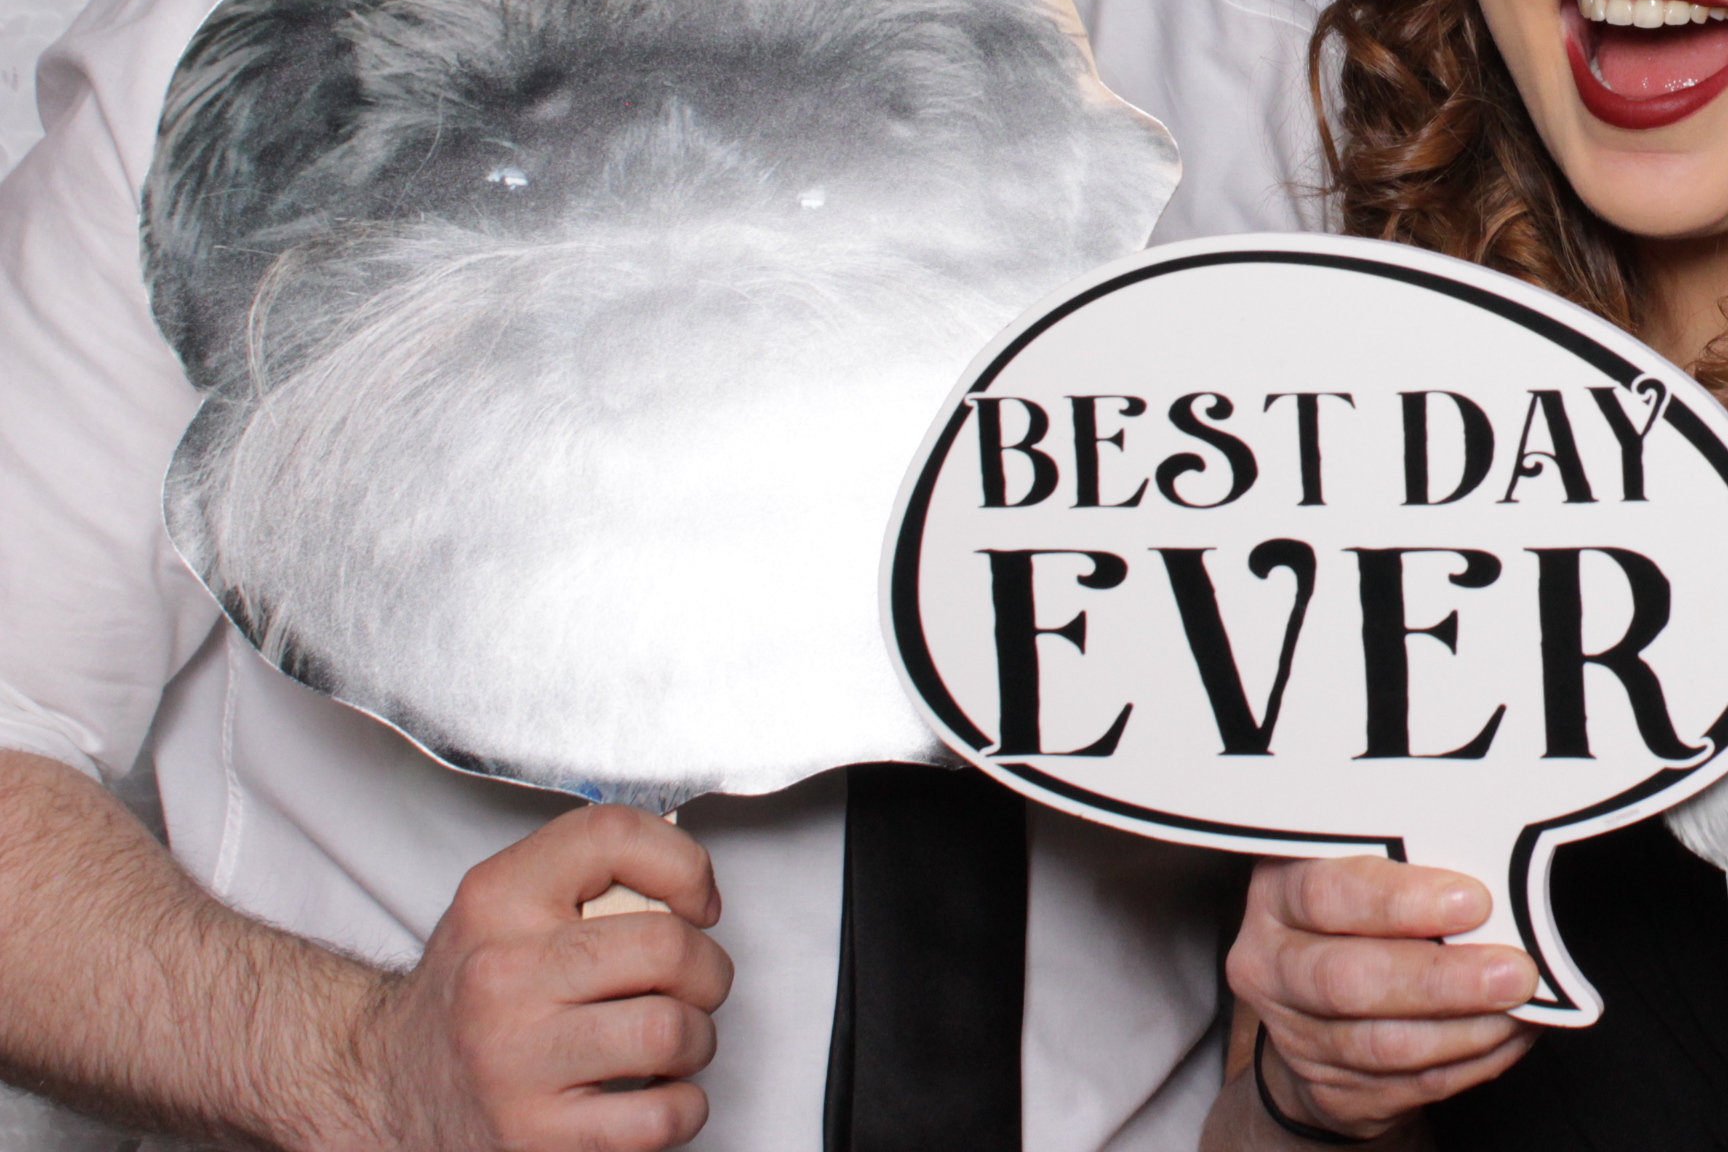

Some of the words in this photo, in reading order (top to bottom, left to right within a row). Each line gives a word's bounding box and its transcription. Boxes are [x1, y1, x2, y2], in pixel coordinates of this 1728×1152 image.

[971, 392, 1356, 508] BEST
[1396, 379, 1667, 505] DAY
[973, 538, 1710, 760] EVER
